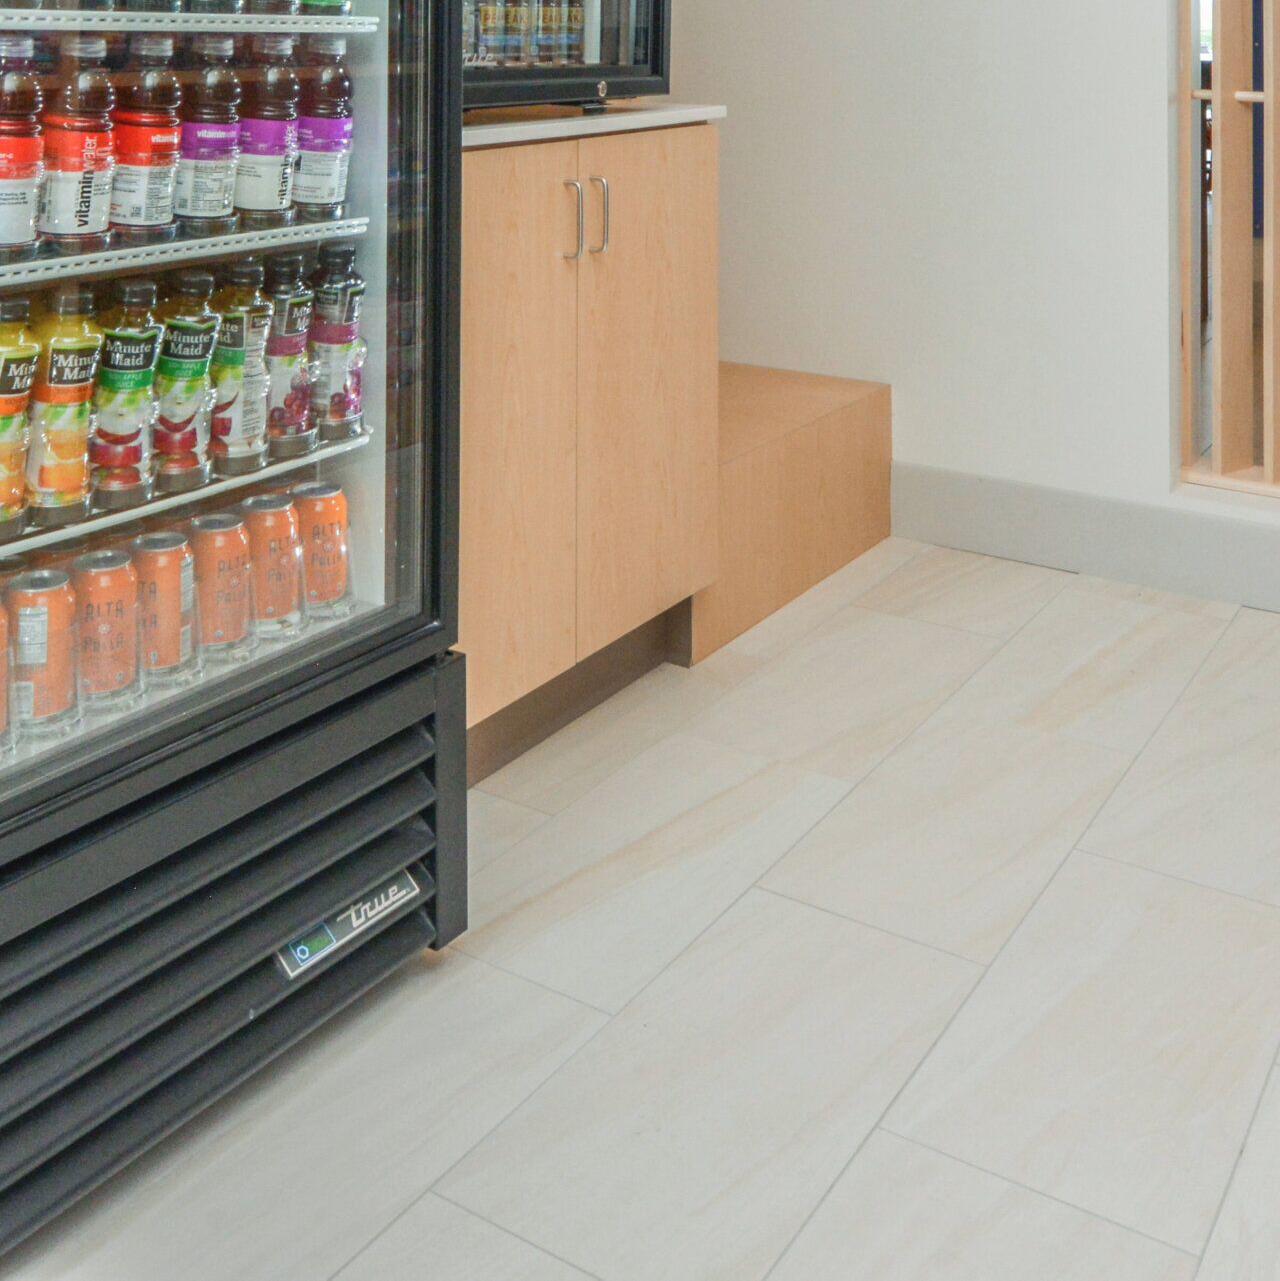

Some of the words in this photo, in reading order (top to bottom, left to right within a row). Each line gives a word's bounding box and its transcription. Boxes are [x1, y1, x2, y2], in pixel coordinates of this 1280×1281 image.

[166, 329, 210, 345] Minute
[106, 338, 151, 354] Minute
[170, 342, 205, 356] Maid
[56, 353, 99, 368] Minu
[110, 352, 145, 367] Maid
